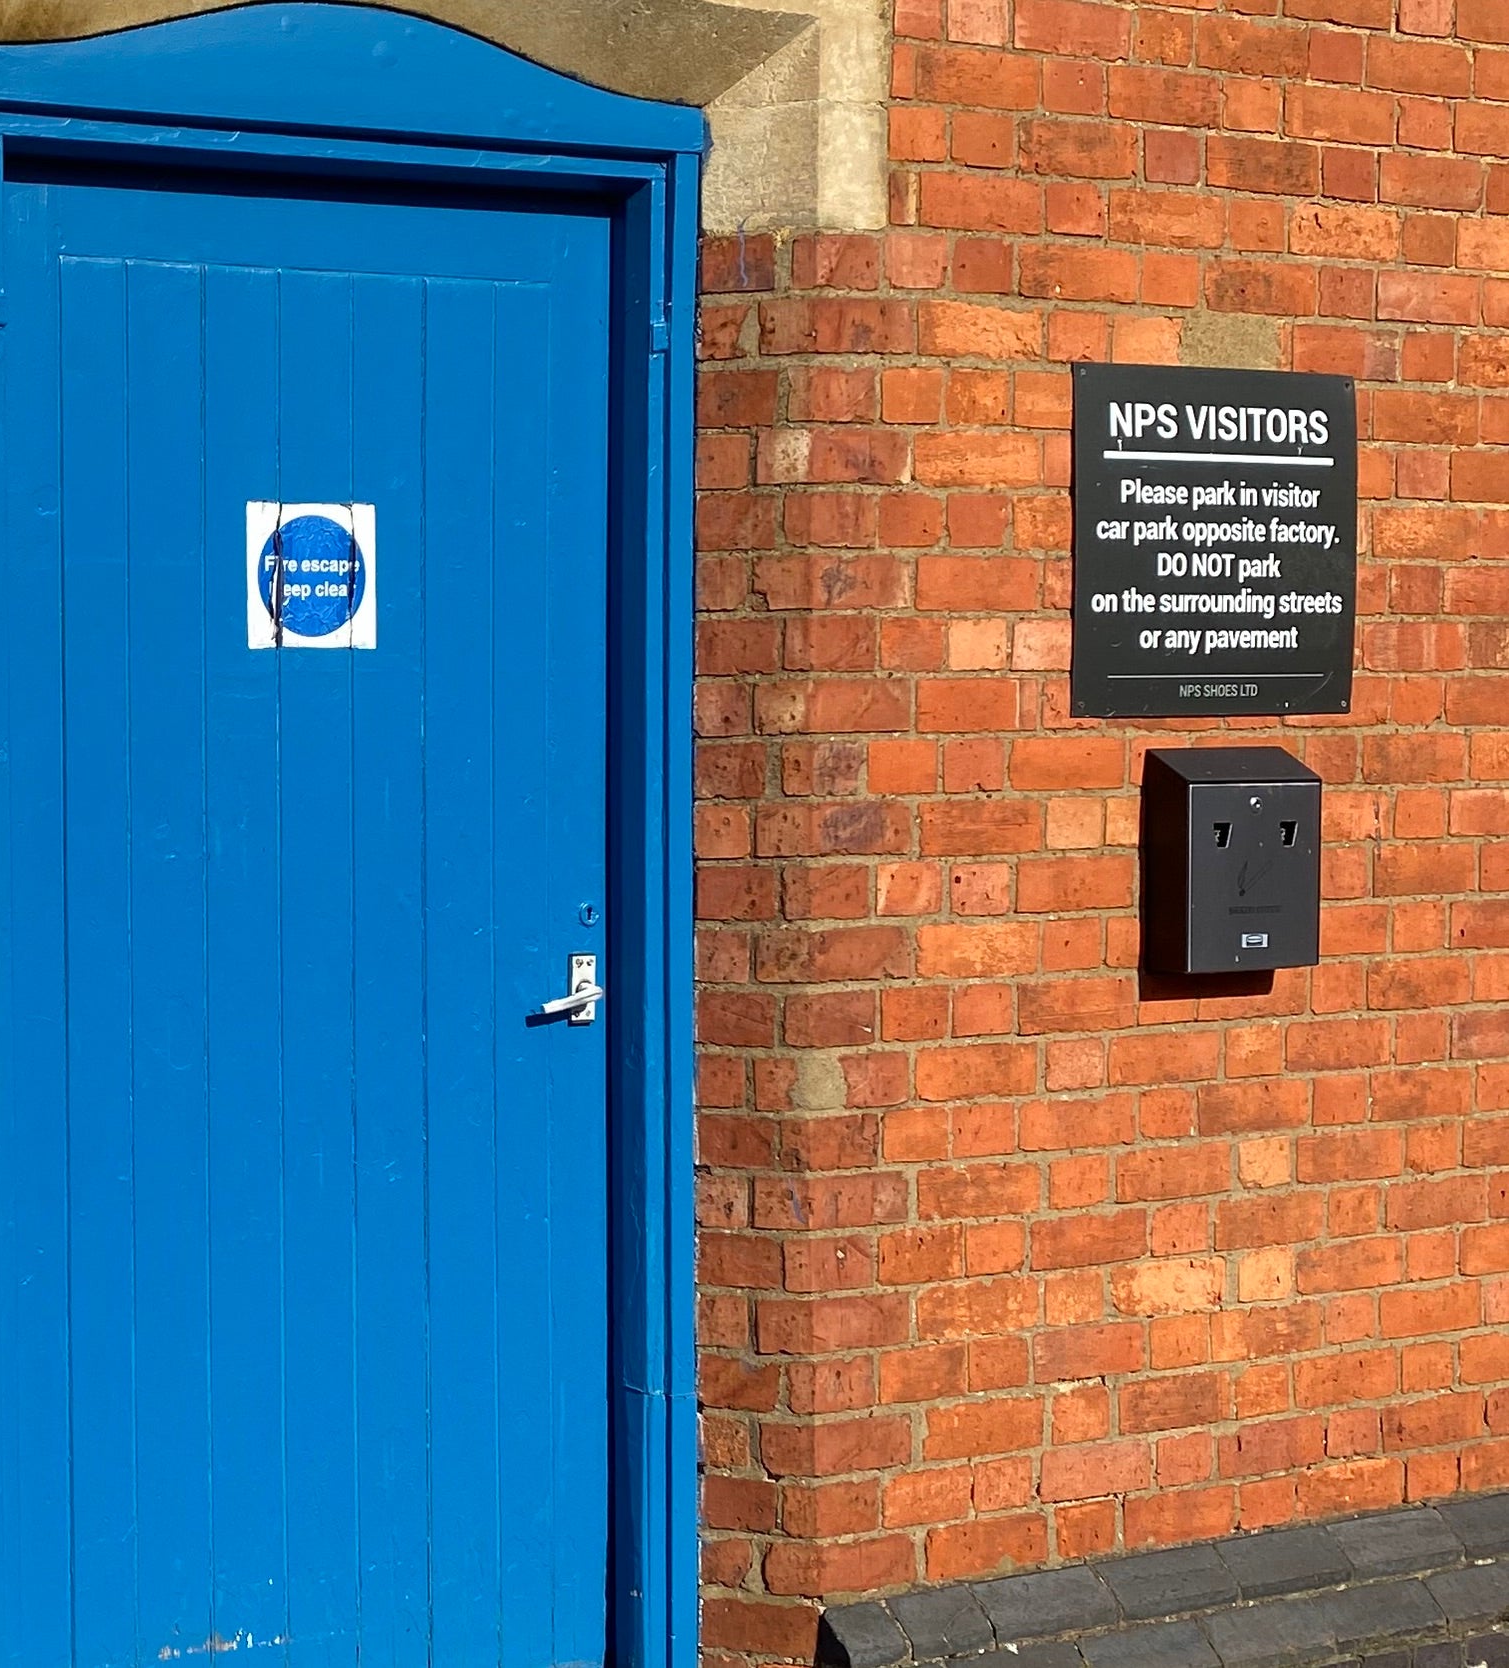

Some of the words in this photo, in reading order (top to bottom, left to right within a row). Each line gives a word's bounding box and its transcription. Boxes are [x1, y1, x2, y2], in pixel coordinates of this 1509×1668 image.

[1110, 403, 1177, 438] NPS
[1186, 405, 1328, 444] VISITORS
[1121, 479, 1188, 504] Please
[1193, 481, 1236, 510] park
[1240, 481, 1257, 506] in
[1262, 482, 1320, 507] visitor
[1096, 521, 1130, 539] car
[1134, 515, 1178, 545] park
[1182, 517, 1266, 547] opposite
[1269, 517, 1339, 549] factory.
[1158, 553, 1187, 576] DO
[1192, 553, 1235, 577] NOT
[1239, 553, 1281, 583] park
[1091, 594, 1117, 612] on
[1122, 587, 1155, 612] the
[1159, 588, 1275, 619] surrounding
[1279, 592, 1342, 613] streets
[1140, 630, 1162, 648] or
[1165, 630, 1200, 654] any
[1205, 627, 1298, 654] pavement
[1180, 685, 1201, 697] NPS
[1203, 685, 1238, 697] SHOES
[1240, 684, 1257, 696] LTD
